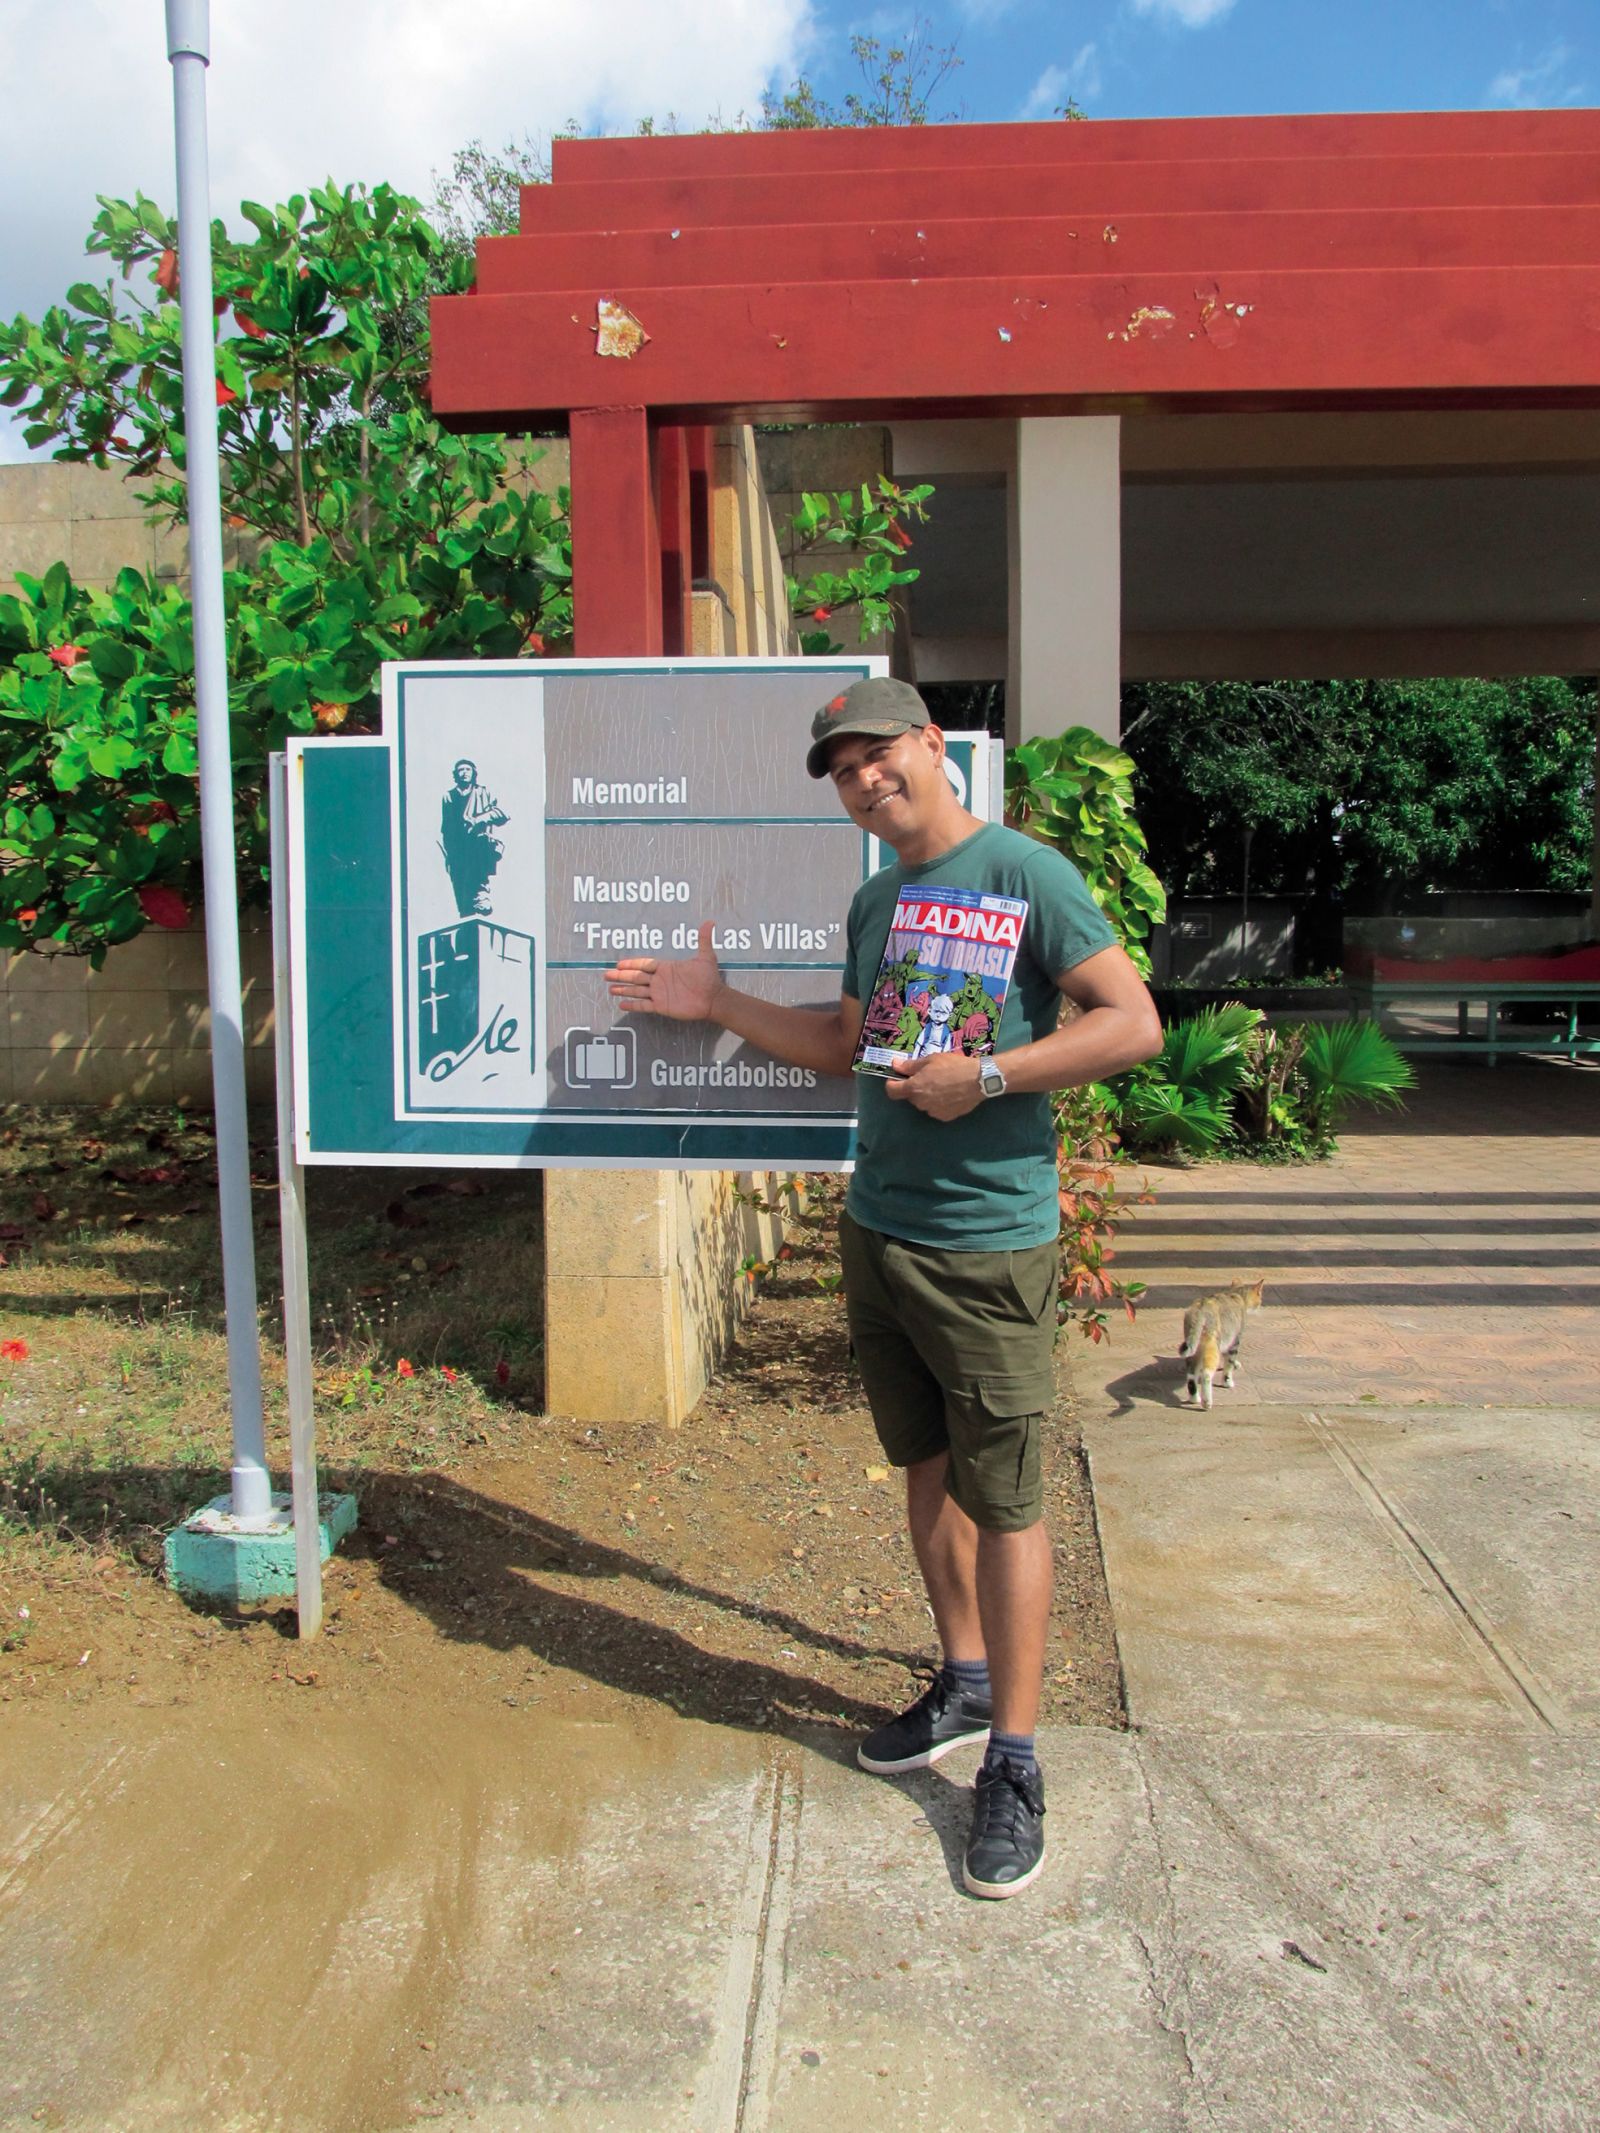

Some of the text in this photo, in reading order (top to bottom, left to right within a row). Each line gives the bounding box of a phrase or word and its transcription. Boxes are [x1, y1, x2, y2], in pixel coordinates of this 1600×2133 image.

[572, 776, 687, 804] Memorial
[573, 875, 690, 903] Mausoleo
[573, 922, 840, 950] “Frente de Las Villas”
[892, 903, 1019, 947] MLADINA
[651, 1058, 817, 1088] Guardabolsos
